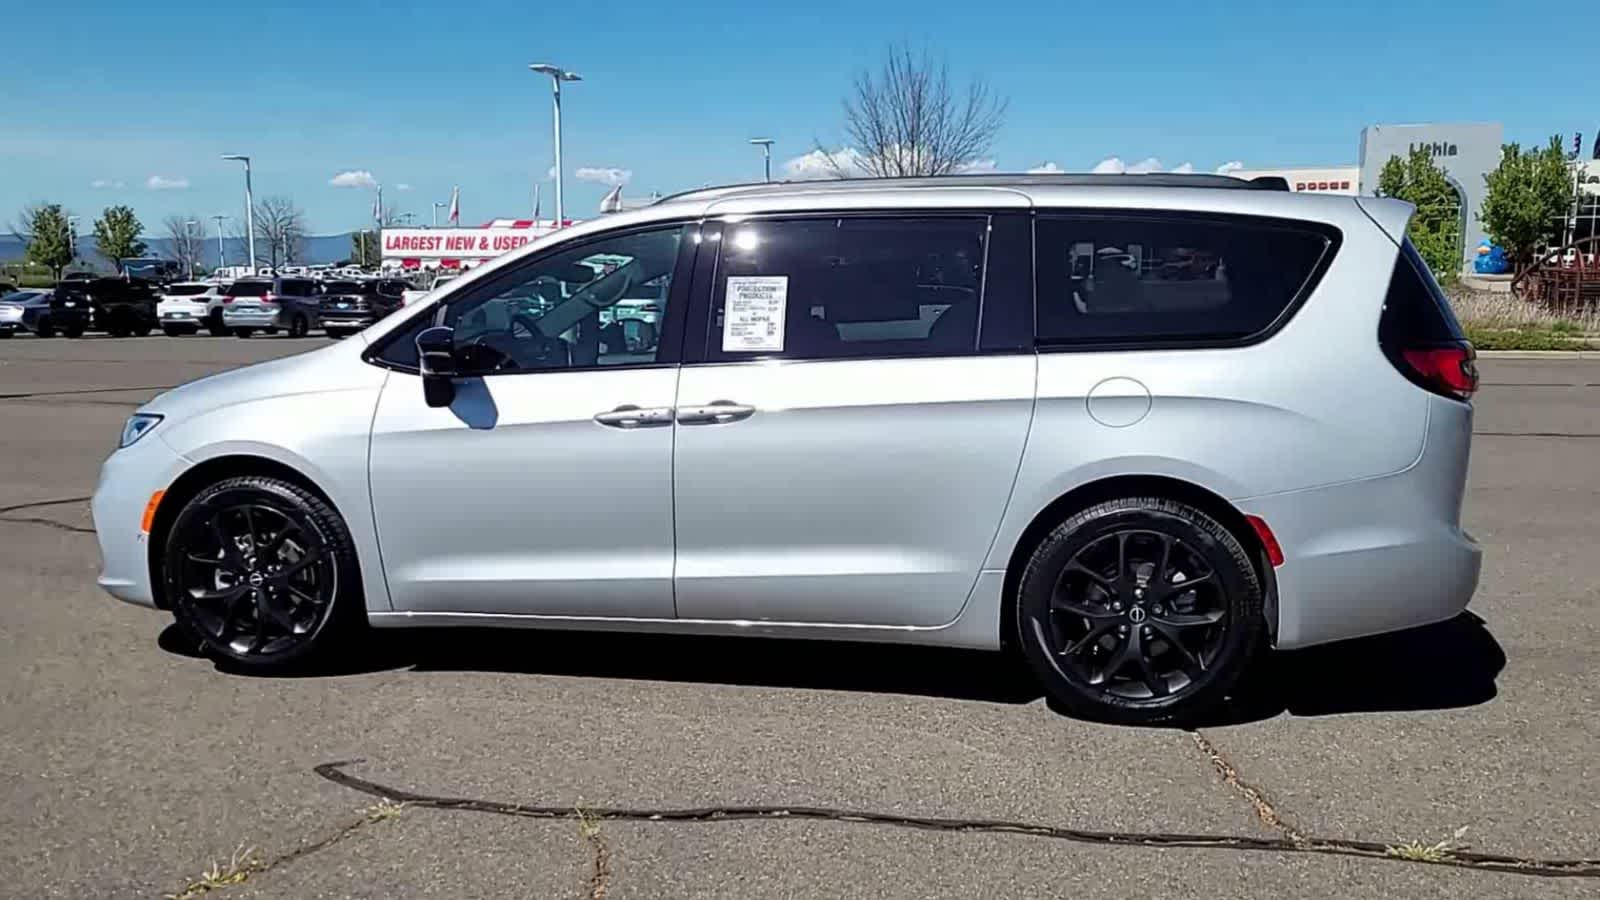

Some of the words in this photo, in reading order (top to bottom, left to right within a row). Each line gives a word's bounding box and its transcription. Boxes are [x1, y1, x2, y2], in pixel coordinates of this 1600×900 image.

[386, 236, 443, 250] LARGEST
[445, 236, 477, 250] NEW
[479, 236, 489, 250] &
[493, 236, 528, 250] USED
